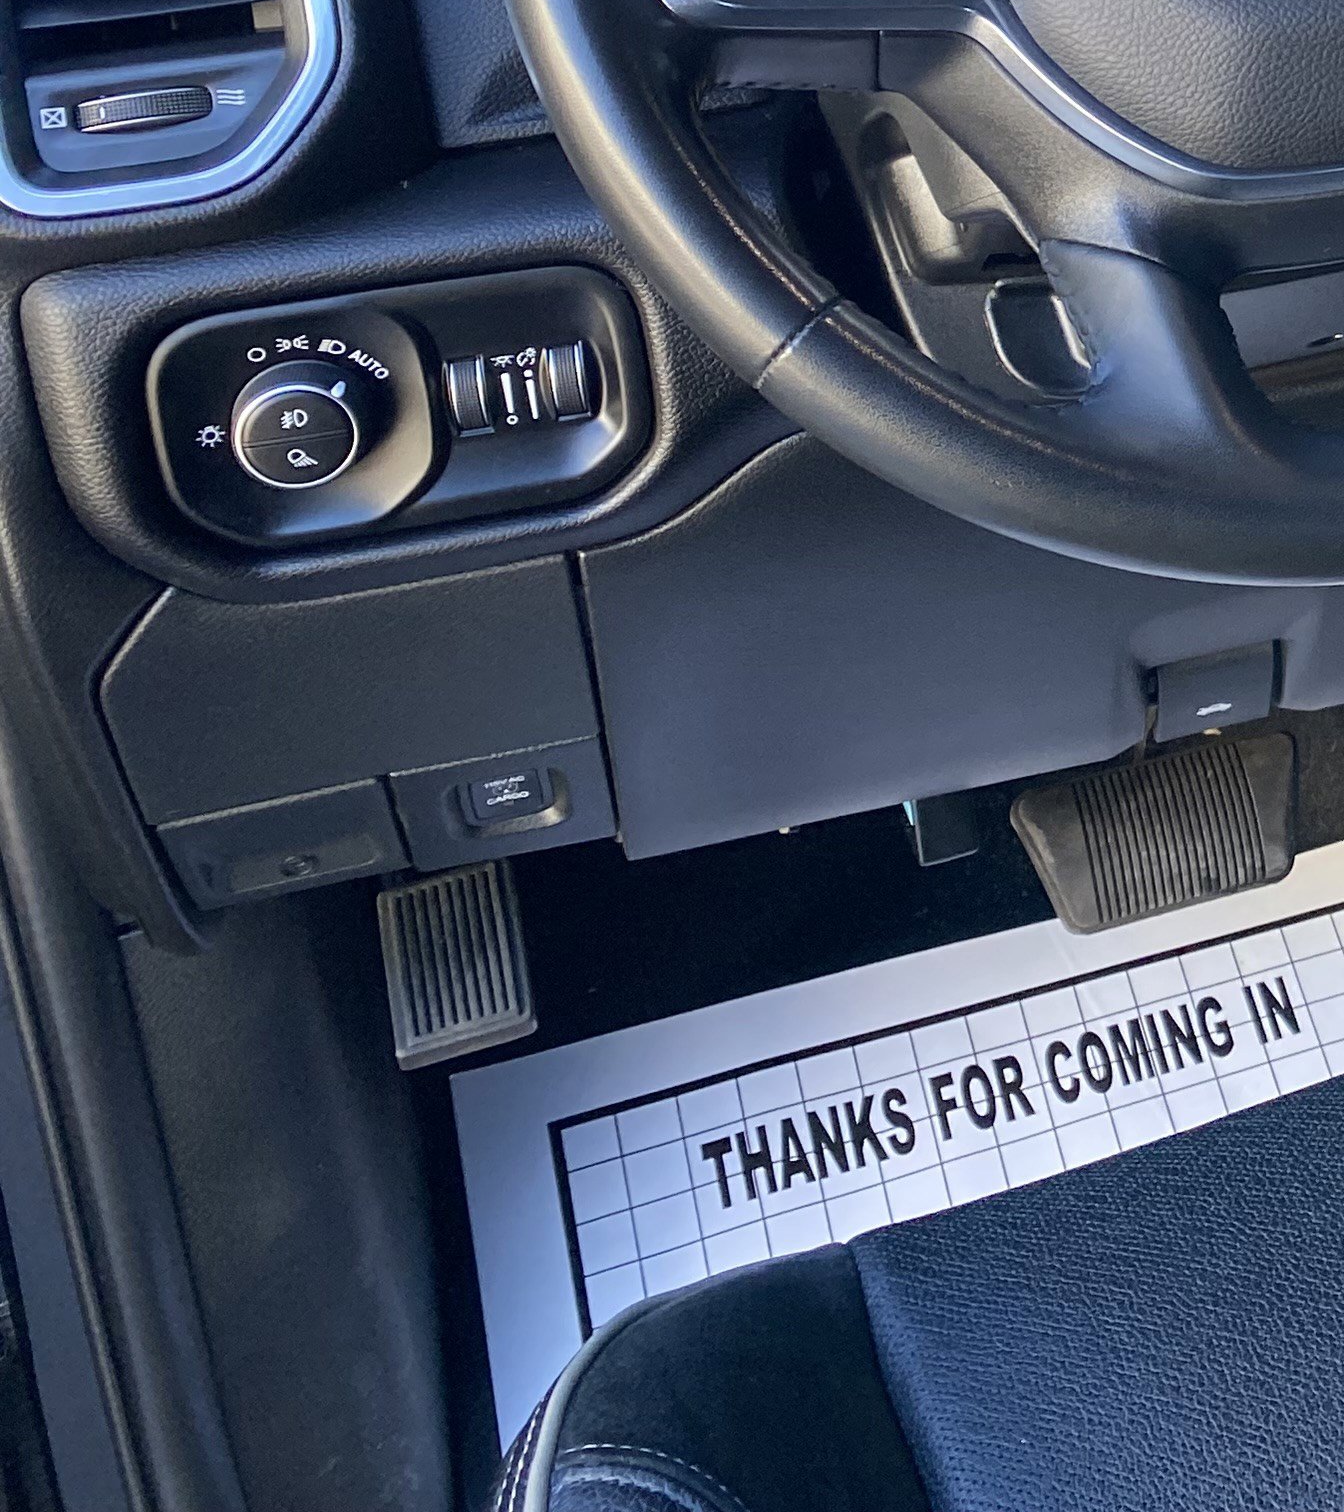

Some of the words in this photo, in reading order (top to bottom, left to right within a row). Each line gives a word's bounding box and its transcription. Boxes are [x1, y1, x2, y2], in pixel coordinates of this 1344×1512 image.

[347, 349, 390, 382] AUTO
[486, 791, 530, 805] CARGO
[700, 1087, 916, 1209] THANKS
[927, 1057, 1036, 1141] FOR
[1043, 995, 1236, 1104] COMING
[1242, 976, 1301, 1045] IN
